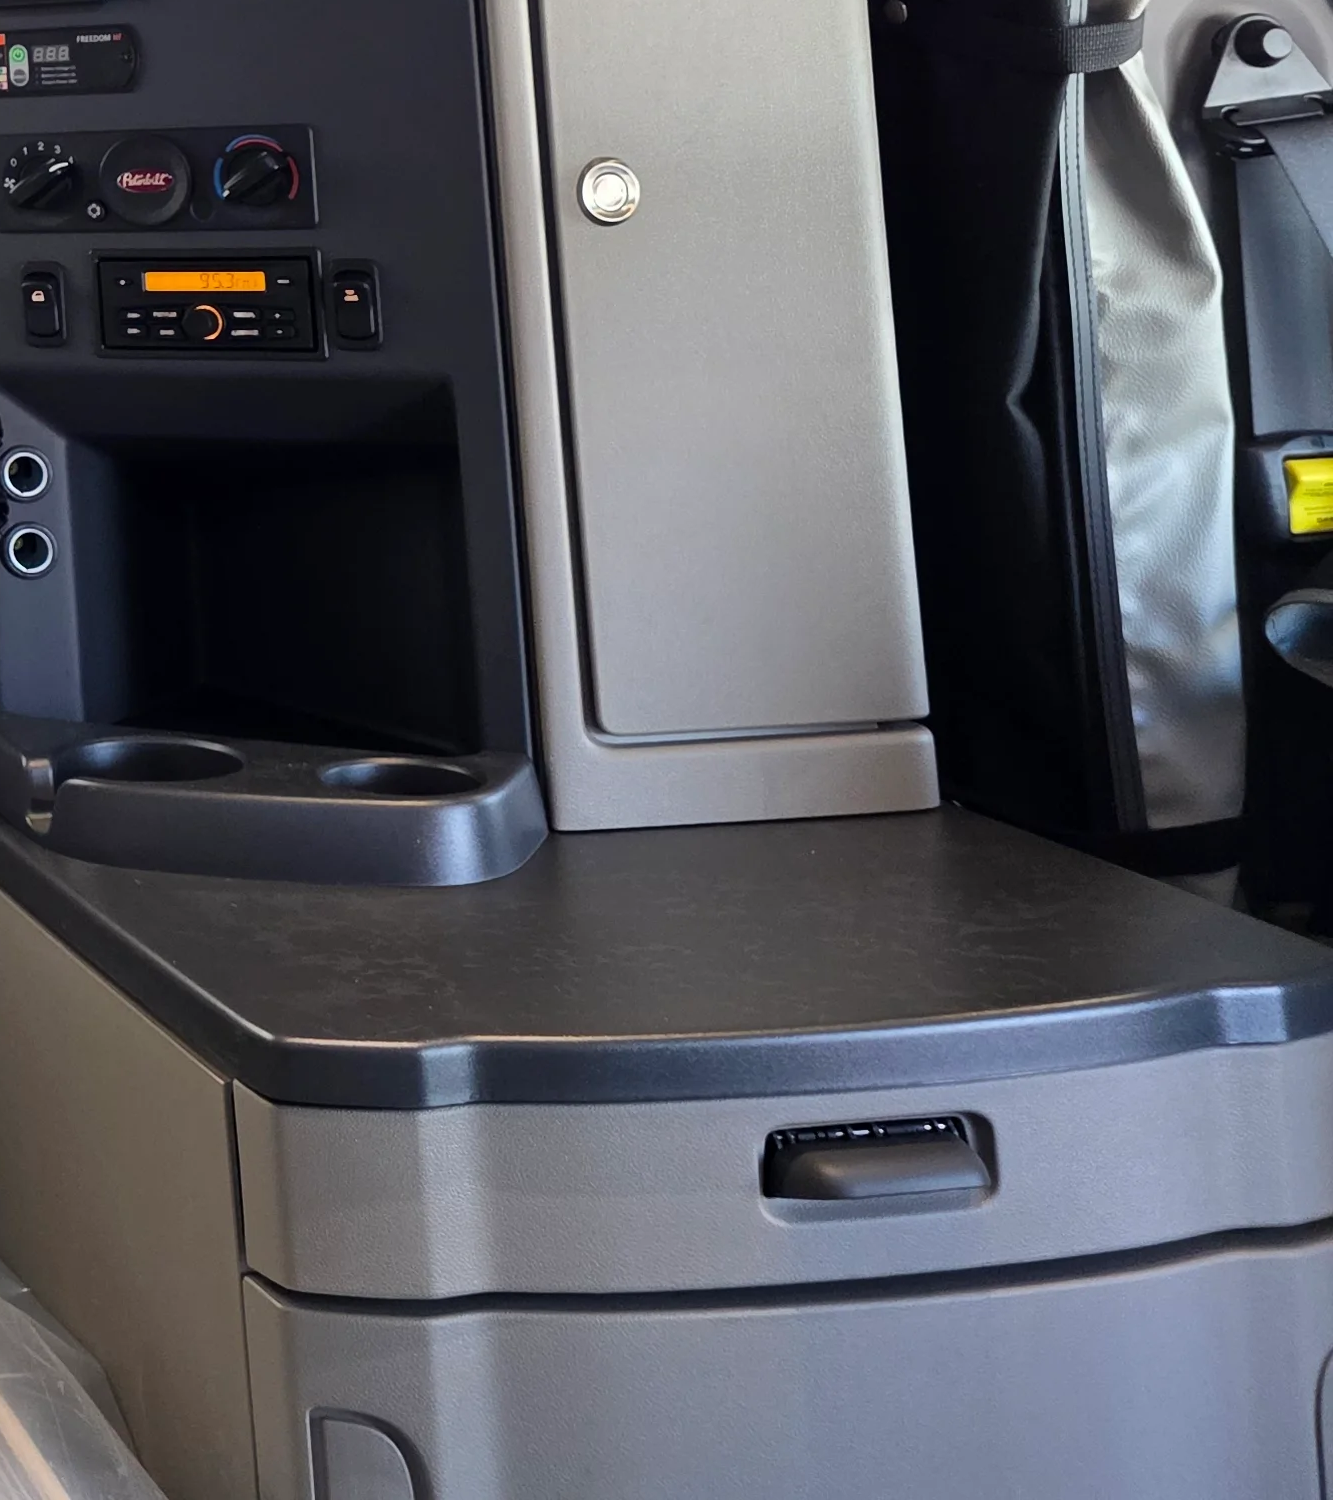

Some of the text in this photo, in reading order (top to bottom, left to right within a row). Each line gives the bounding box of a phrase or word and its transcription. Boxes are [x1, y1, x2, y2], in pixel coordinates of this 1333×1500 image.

[10, 158, 18, 168] 0
[23, 146, 29, 156] 1
[37, 141, 45, 151] 2
[54, 145, 61, 155] 3
